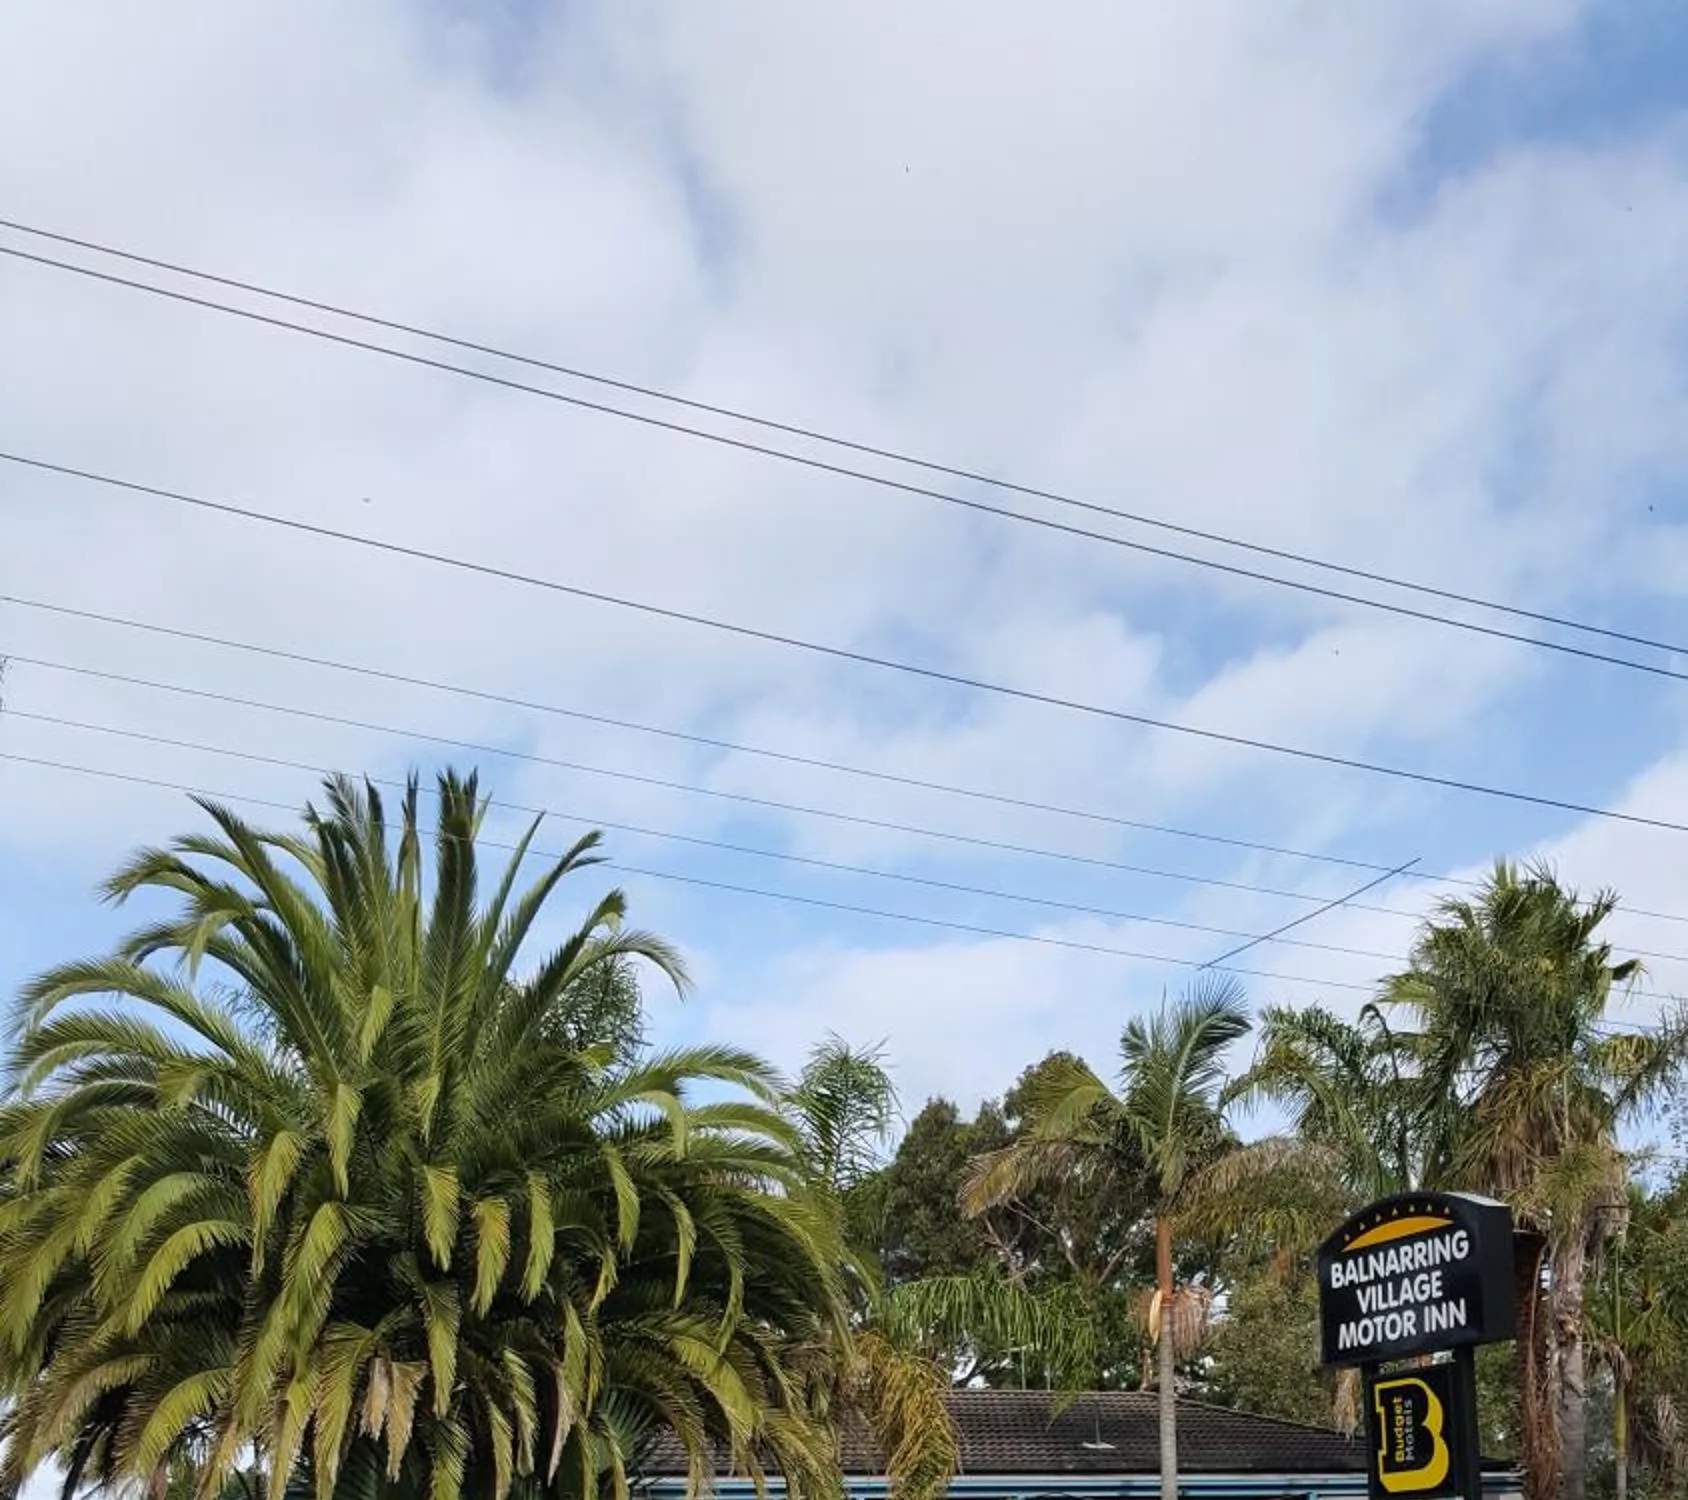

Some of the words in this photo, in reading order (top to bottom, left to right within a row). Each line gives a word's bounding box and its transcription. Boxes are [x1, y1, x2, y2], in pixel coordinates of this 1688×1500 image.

[1330, 1229, 1470, 1290] BALNARRING
[1355, 1269, 1444, 1315] VILLAGE
[1337, 1310, 1417, 1350] MOTOR
[1423, 1297, 1467, 1334] INN
[1392, 1396, 1406, 1464] Budget
[1403, 1398, 1416, 1462] Motels
